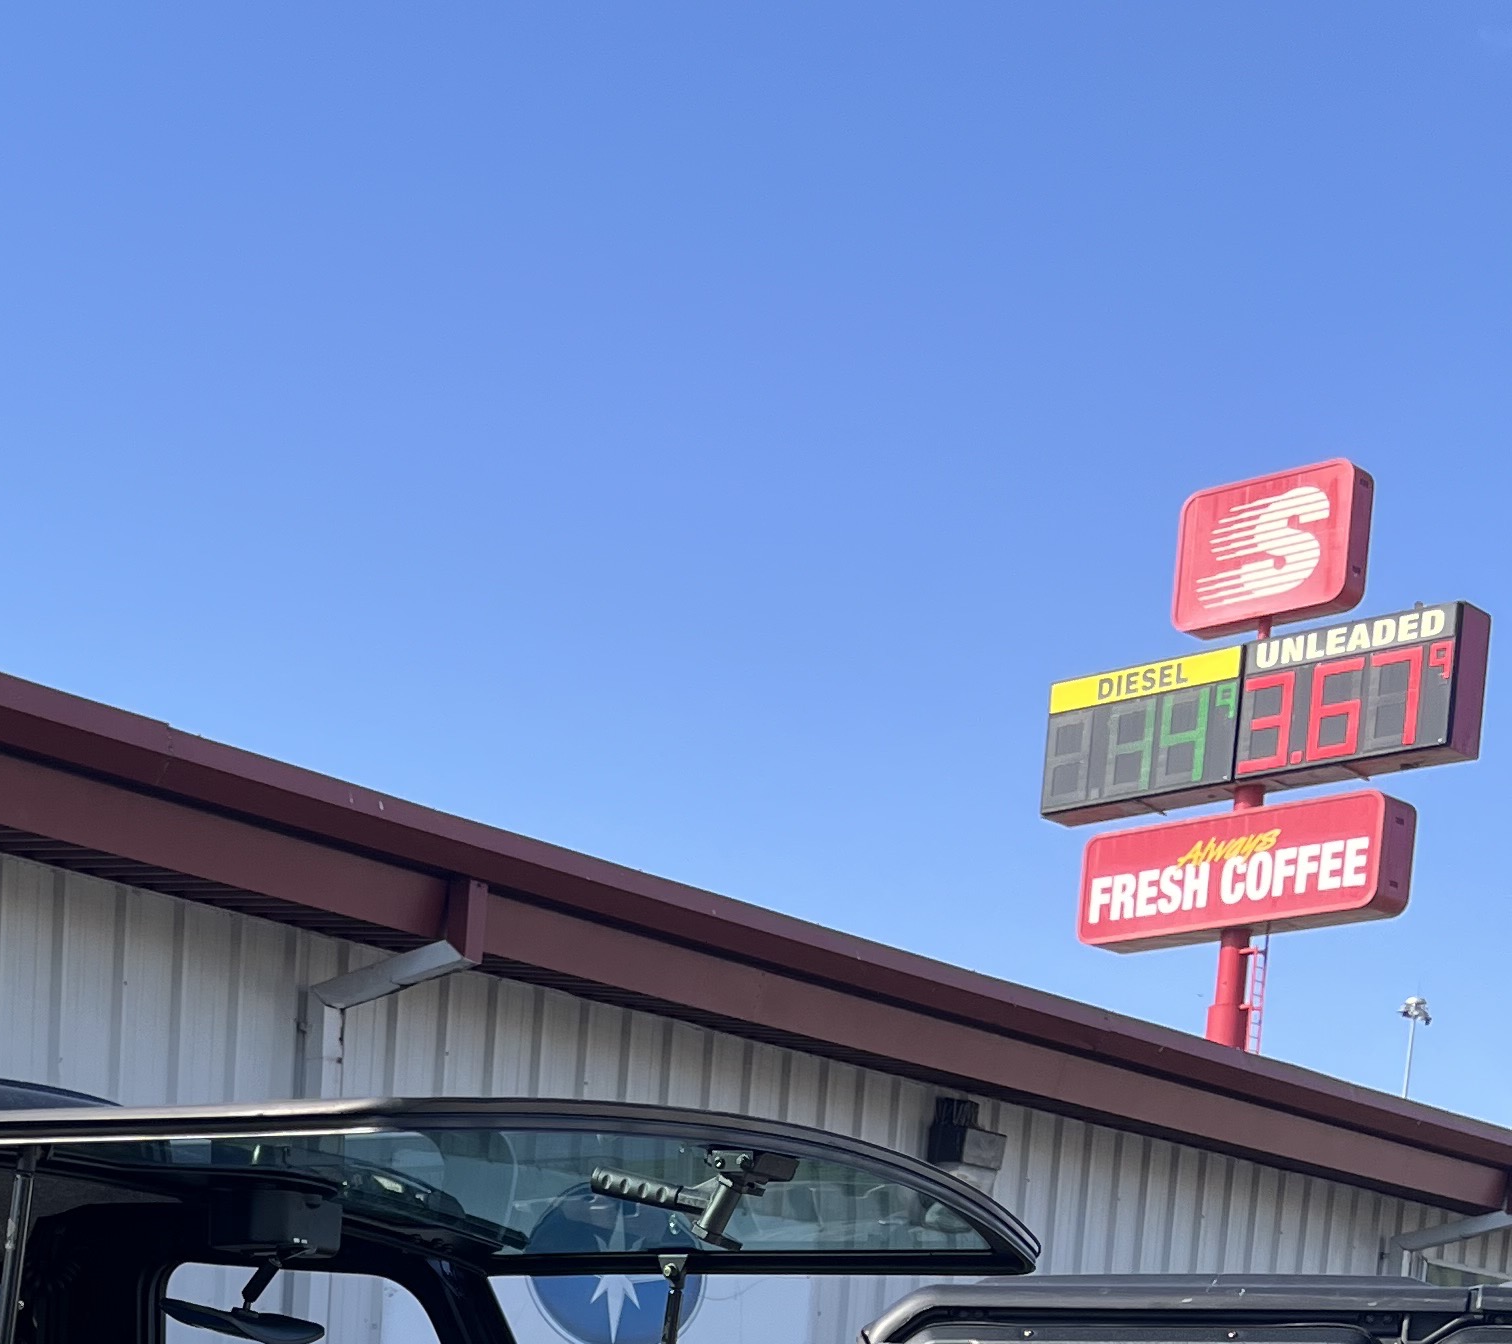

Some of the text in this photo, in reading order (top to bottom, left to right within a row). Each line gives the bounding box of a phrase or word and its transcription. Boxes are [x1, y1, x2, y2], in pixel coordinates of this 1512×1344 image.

[1255, 608, 1445, 669] UNLEADED
[1097, 661, 1189, 700] DIESEL
[1177, 827, 1281, 870] Always
[1088, 836, 1370, 924] FRESH COFFEE
